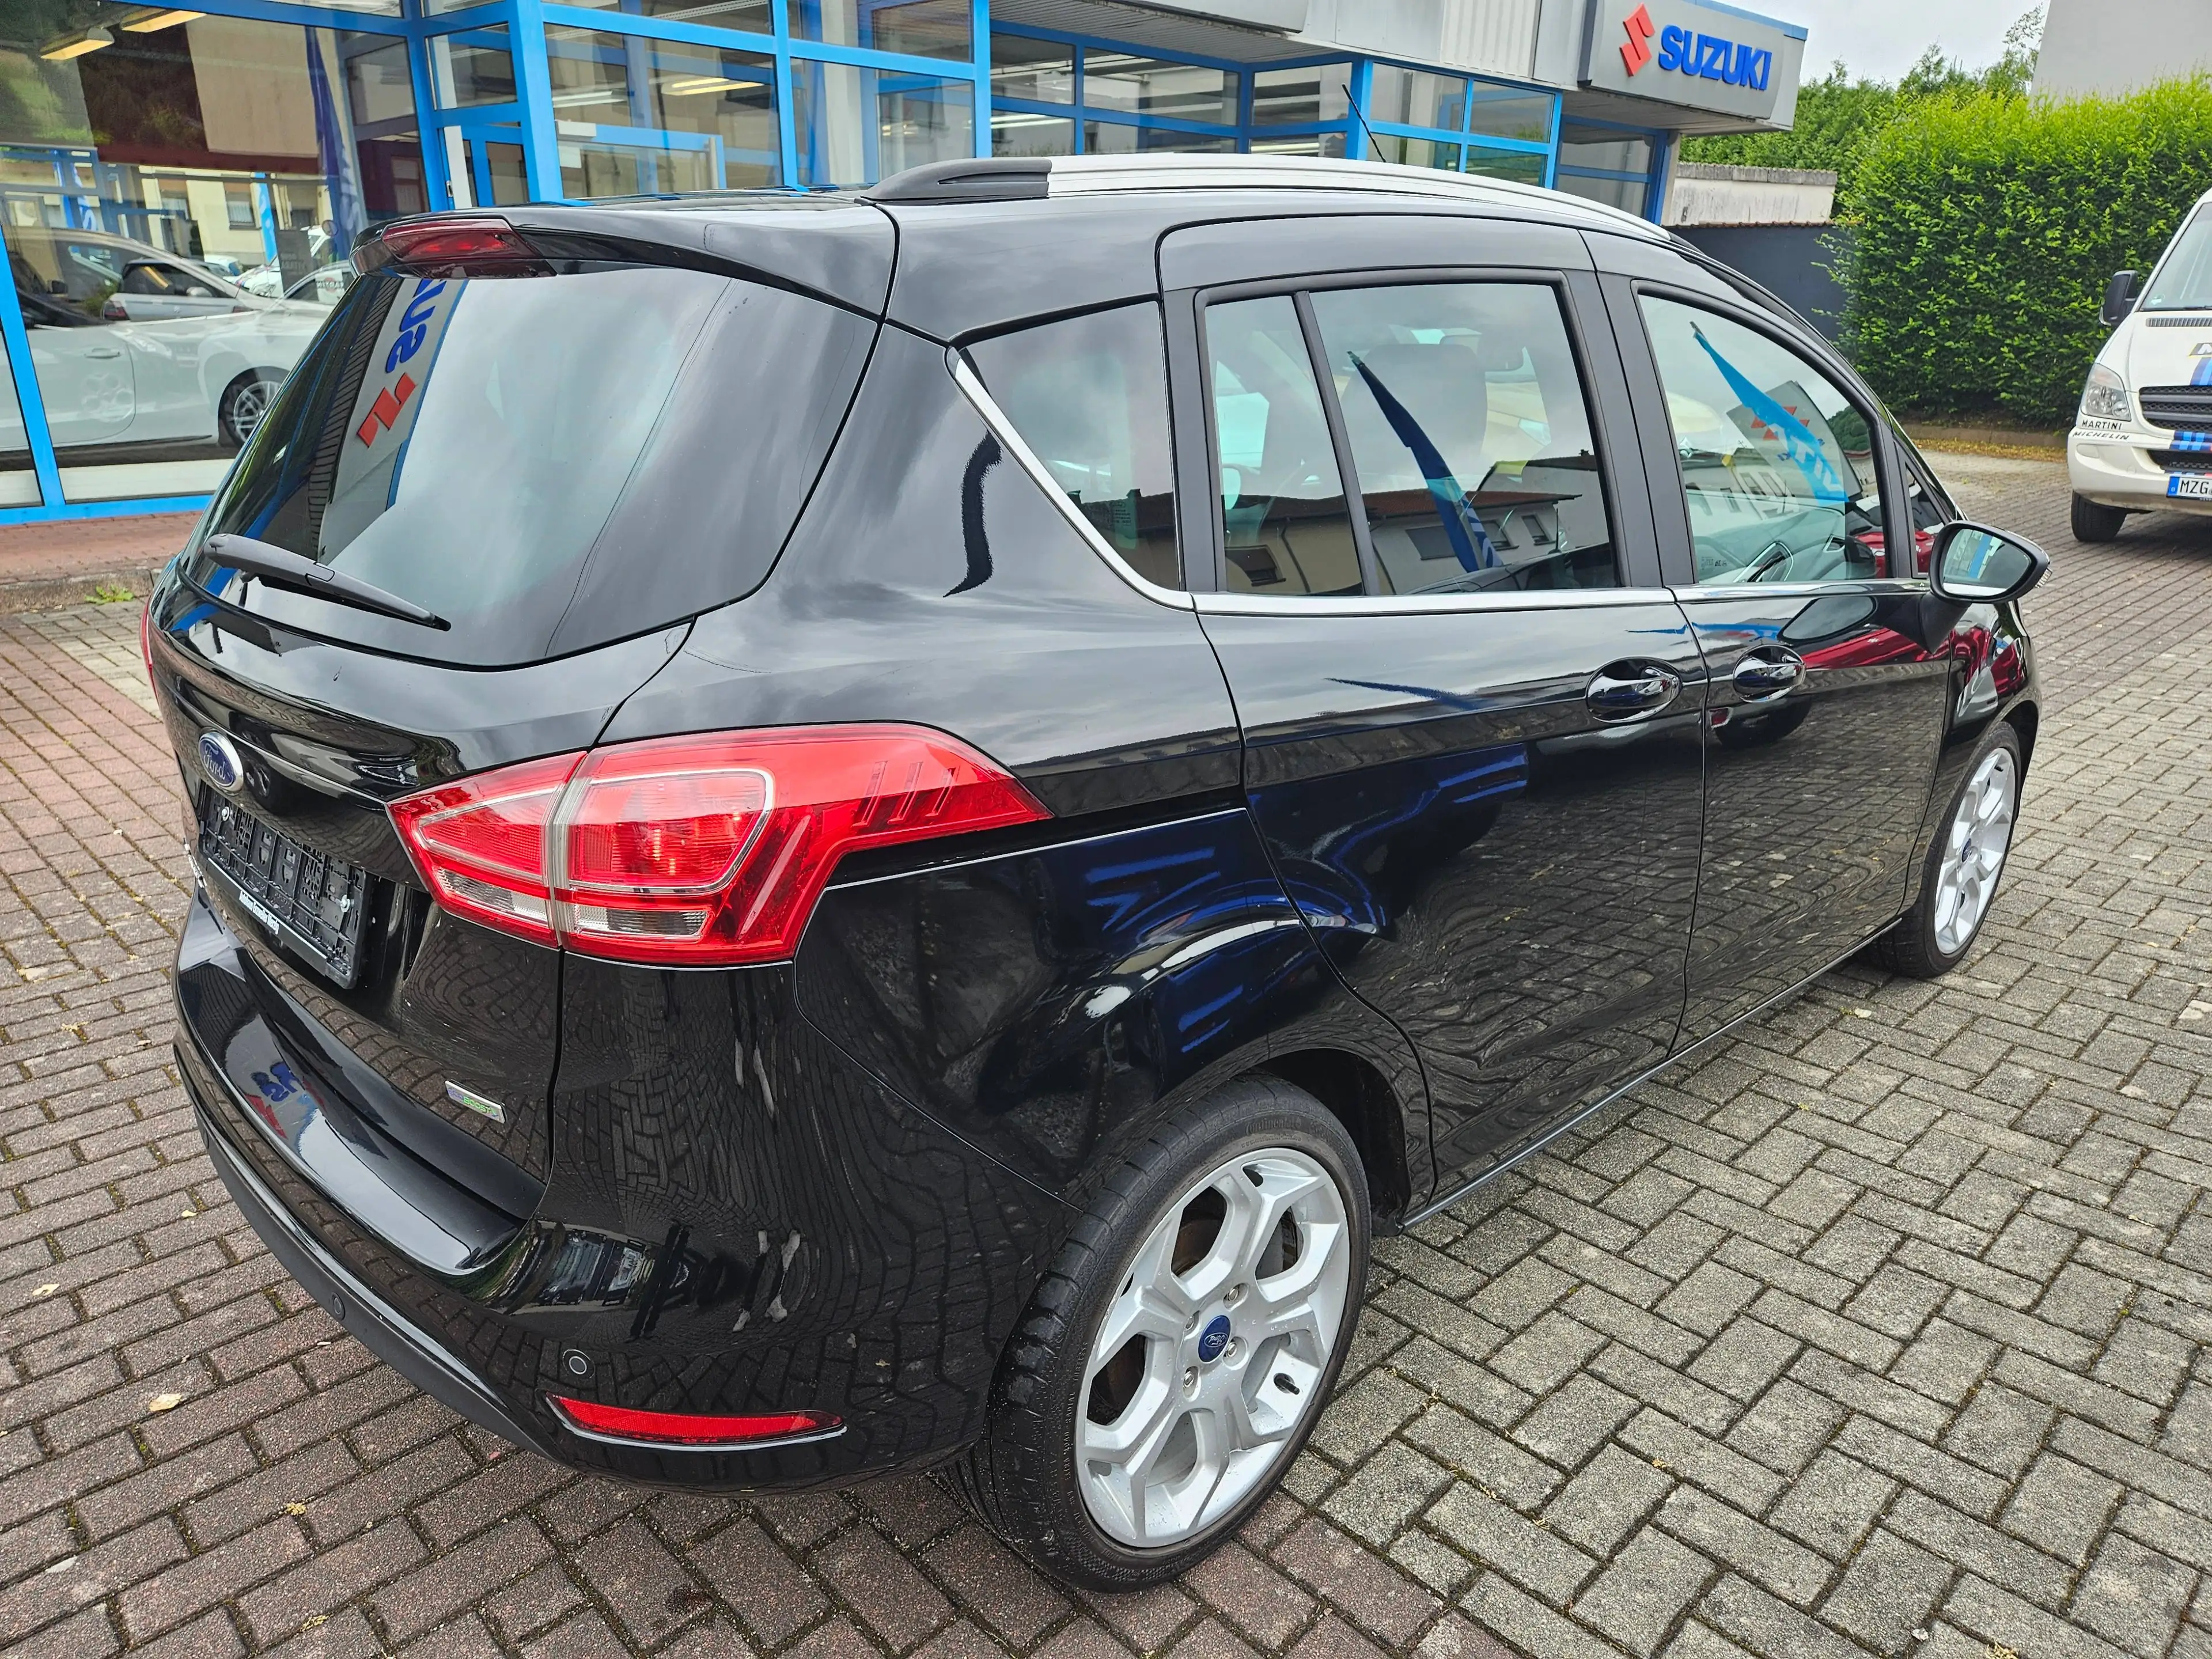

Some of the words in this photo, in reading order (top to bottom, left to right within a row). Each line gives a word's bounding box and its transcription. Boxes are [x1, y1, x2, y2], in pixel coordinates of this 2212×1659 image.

[1658, 24, 1772, 91] SUZUKI
[2082, 419, 2122, 430] MARTINI
[2073, 431, 2129, 440] MICHELIN
[2180, 480, 2209, 494] MZG
[204, 743, 226, 780] Ford
